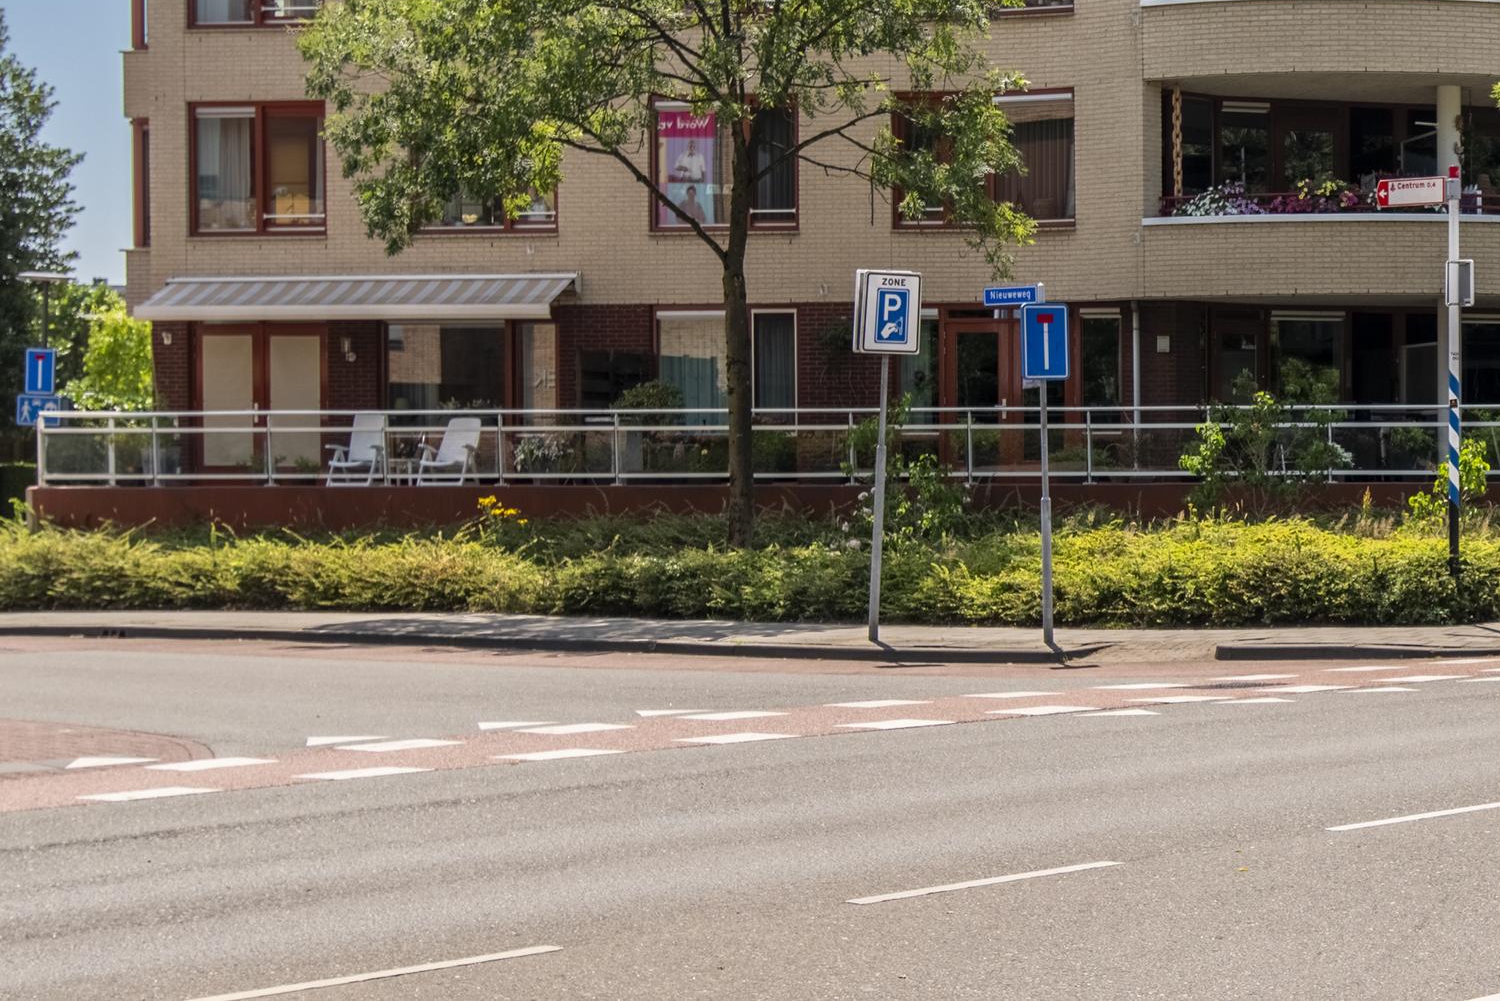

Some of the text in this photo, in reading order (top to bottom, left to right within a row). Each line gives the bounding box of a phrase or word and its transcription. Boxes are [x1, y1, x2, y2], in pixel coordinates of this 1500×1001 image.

[1396, 181, 1425, 190] Centrum
[881, 277, 907, 287] ZONE
[989, 290, 1031, 301] Nieuweweg
[883, 293, 902, 322] P
